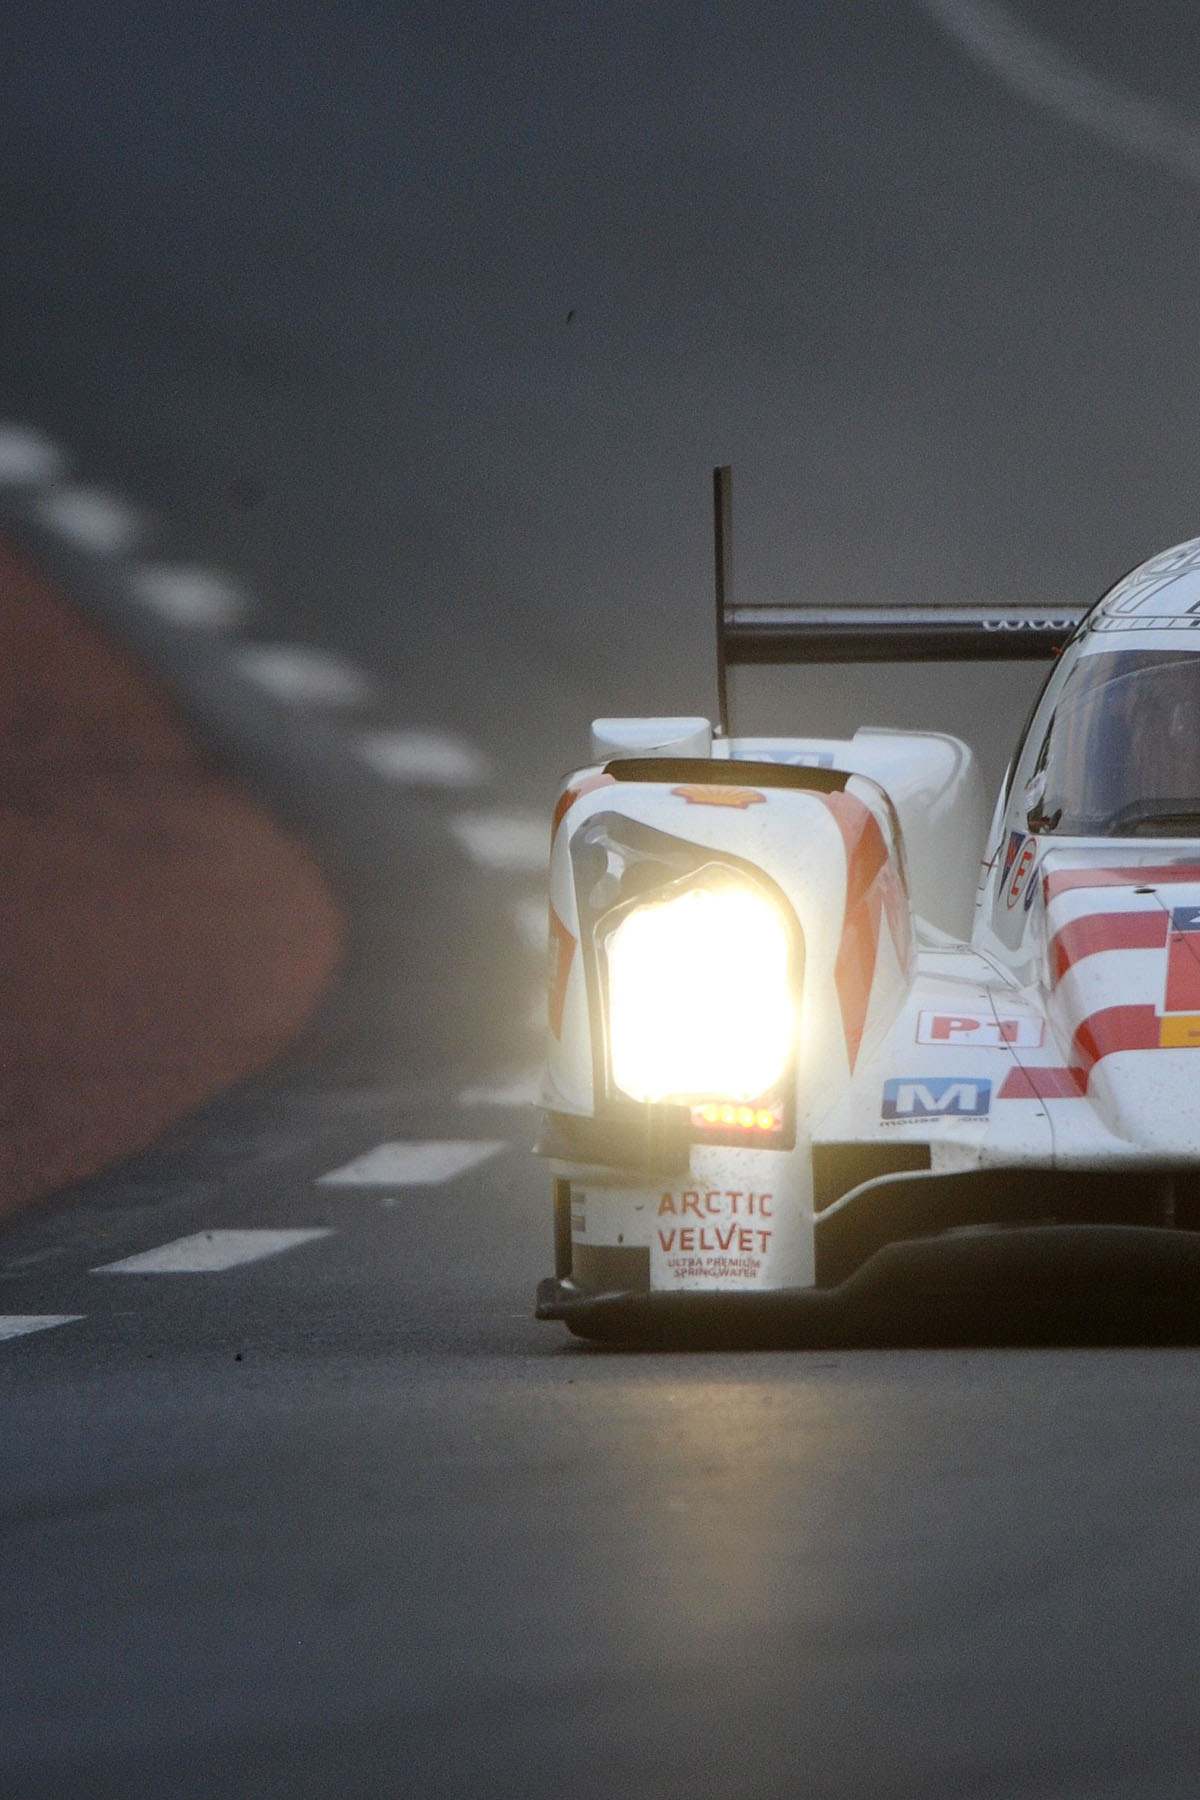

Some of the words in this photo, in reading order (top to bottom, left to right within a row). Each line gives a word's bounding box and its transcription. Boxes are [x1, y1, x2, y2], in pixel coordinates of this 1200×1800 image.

[930, 1015, 1020, 1043] P1
[657, 1190, 774, 1219] ARCTIC
[657, 1222, 773, 1254] VELVET
[667, 1257, 704, 1268] ULTRA
[706, 1257, 761, 1269] PREMIUM
[674, 1268, 717, 1280] SPRING
[717, 1267, 757, 1279] WATER
